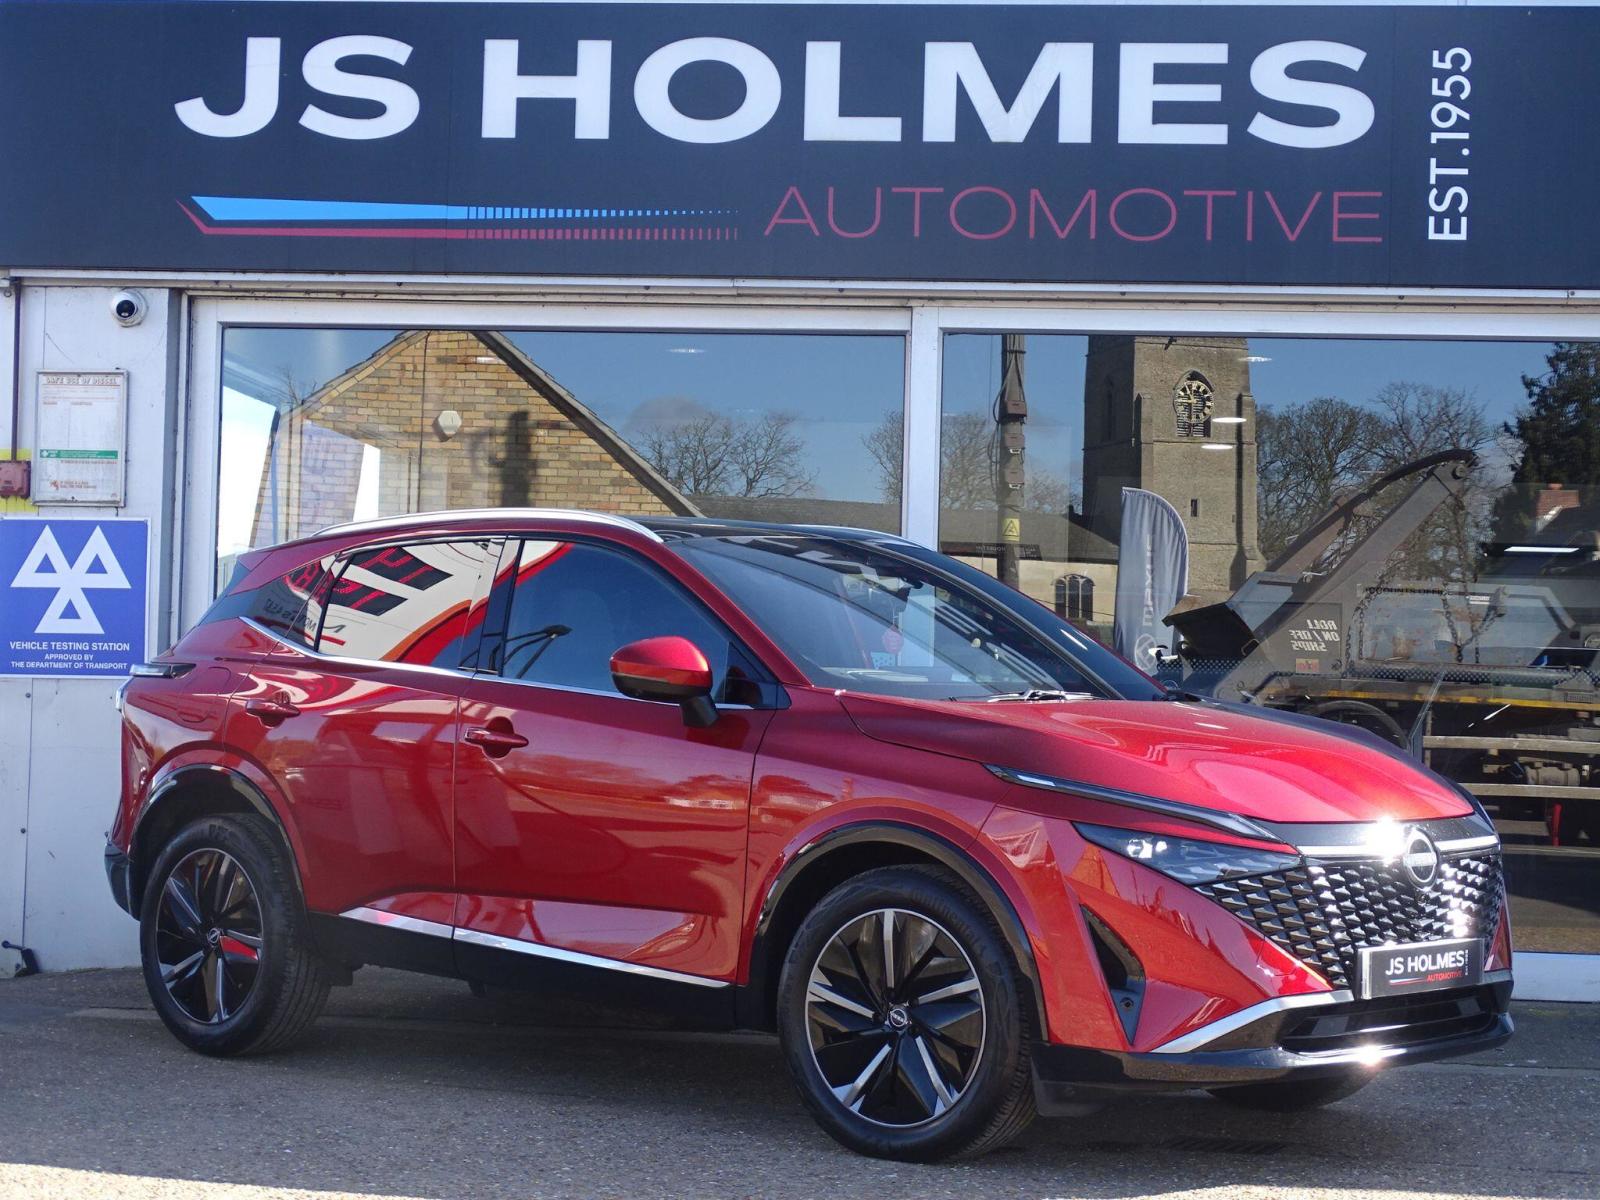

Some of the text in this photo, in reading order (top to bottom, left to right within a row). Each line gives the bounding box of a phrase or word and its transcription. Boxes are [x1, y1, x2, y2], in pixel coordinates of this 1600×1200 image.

[174, 35, 1376, 149] JS HOLMES
[1428, 47, 1472, 241] EST.1955
[764, 186, 1384, 244] AUTOMOTIVE
[9, 641, 130, 651] VEHICLE TESTING STATION
[44, 653, 83, 661] APPROVED
[11, 660, 25, 668] THE
[26, 661, 72, 669] DEPARTMENT
[85, 662, 128, 670] TRANSPORT
[1385, 950, 1465, 976] JS HOLMES
